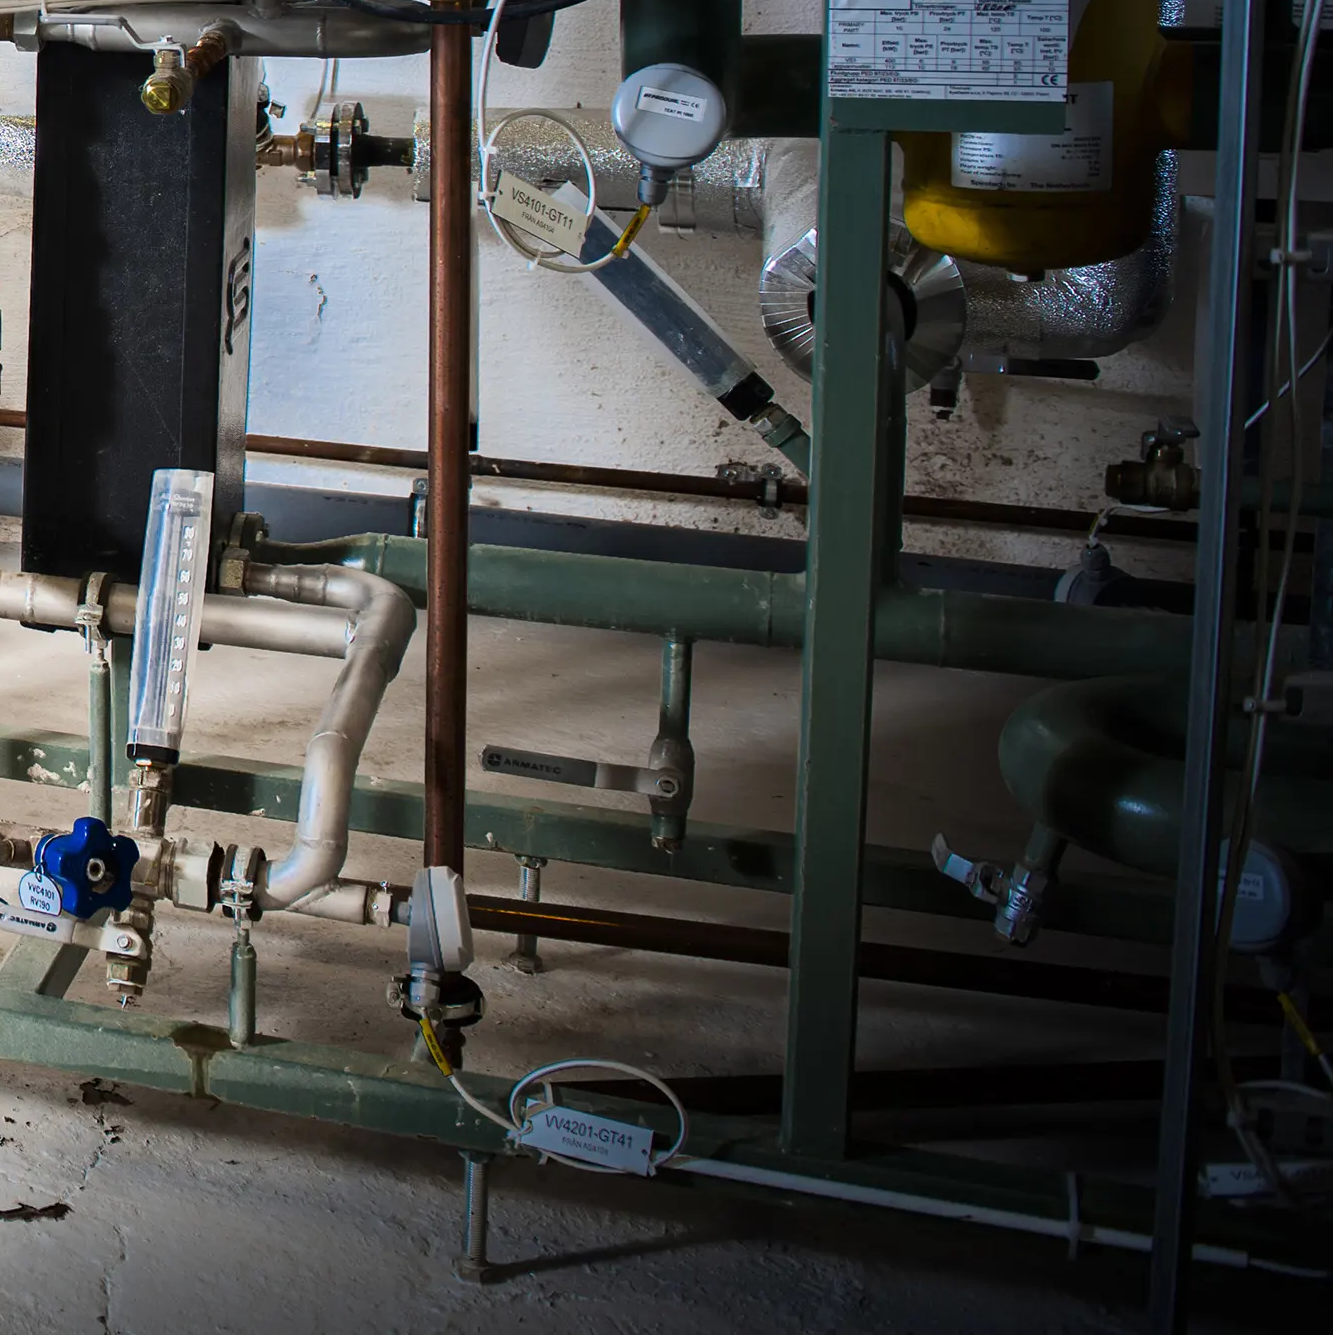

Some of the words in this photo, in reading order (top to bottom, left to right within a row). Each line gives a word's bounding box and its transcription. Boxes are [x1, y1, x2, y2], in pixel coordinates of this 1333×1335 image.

[511, 186, 574, 230] VS4101-GT11
[503, 757, 562, 775] ARMATEC
[27, 881, 55, 901] VVC4101
[545, 1113, 633, 1149] VV4201-GT41
